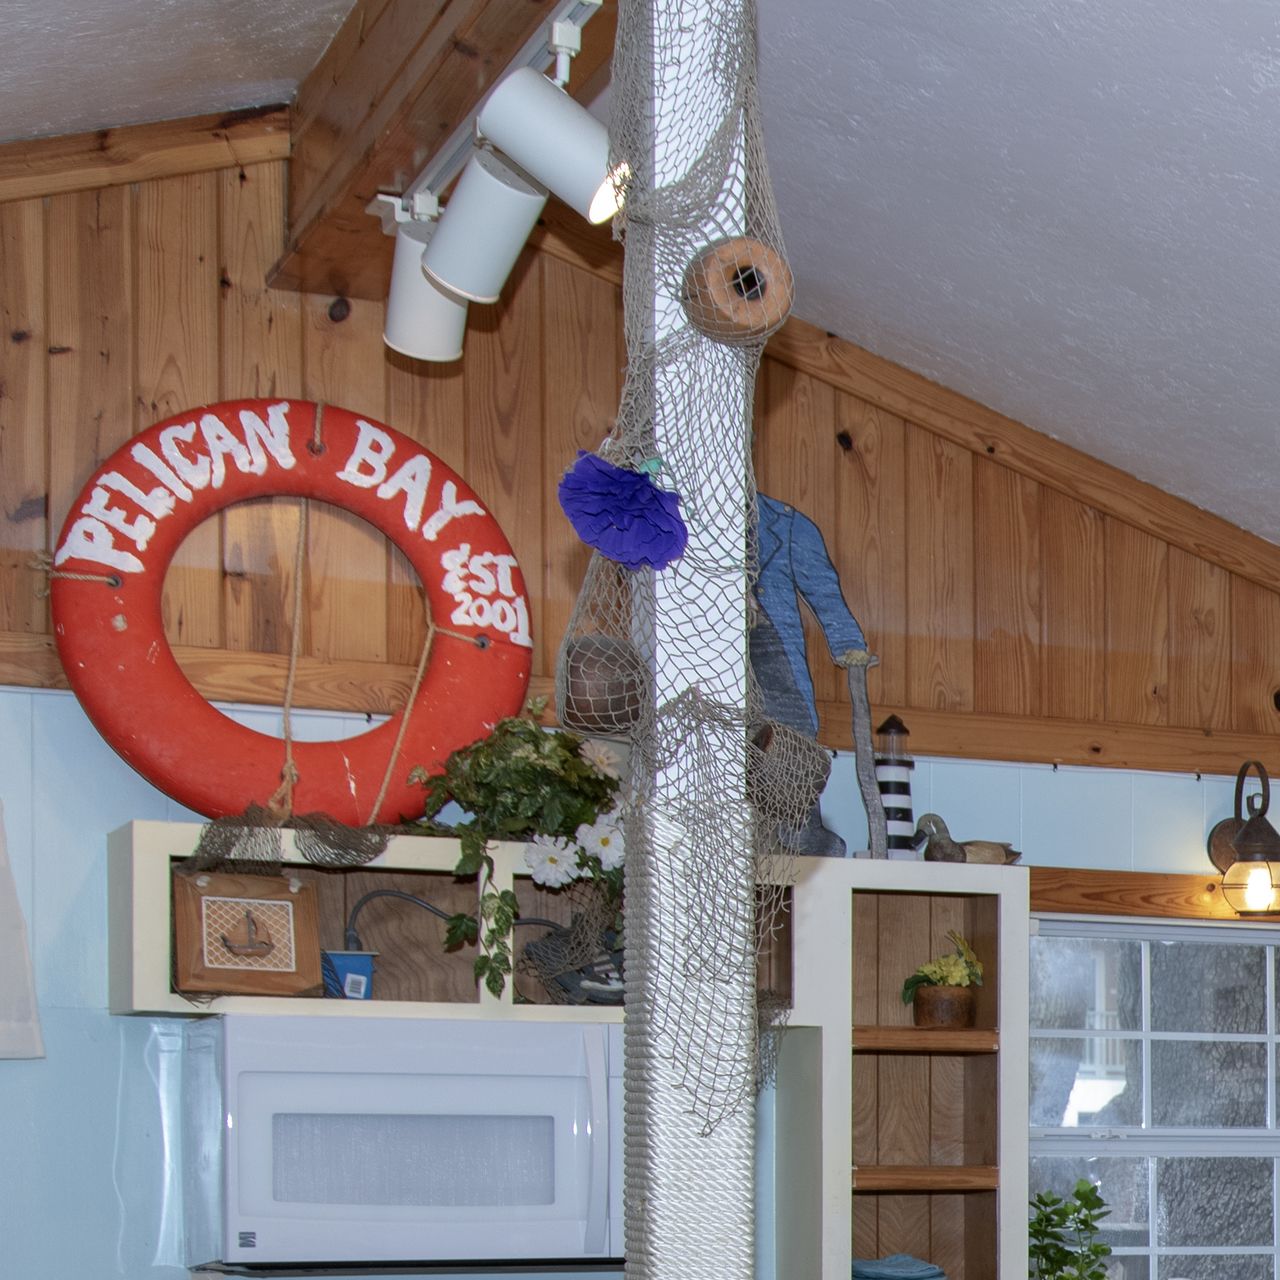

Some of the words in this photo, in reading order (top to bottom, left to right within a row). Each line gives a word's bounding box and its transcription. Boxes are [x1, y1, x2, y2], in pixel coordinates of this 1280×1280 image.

[54, 402, 296, 574] PELICAN
[337, 420, 486, 541] BAY
[441, 544, 518, 598] EST
[450, 592, 533, 648] 2001
